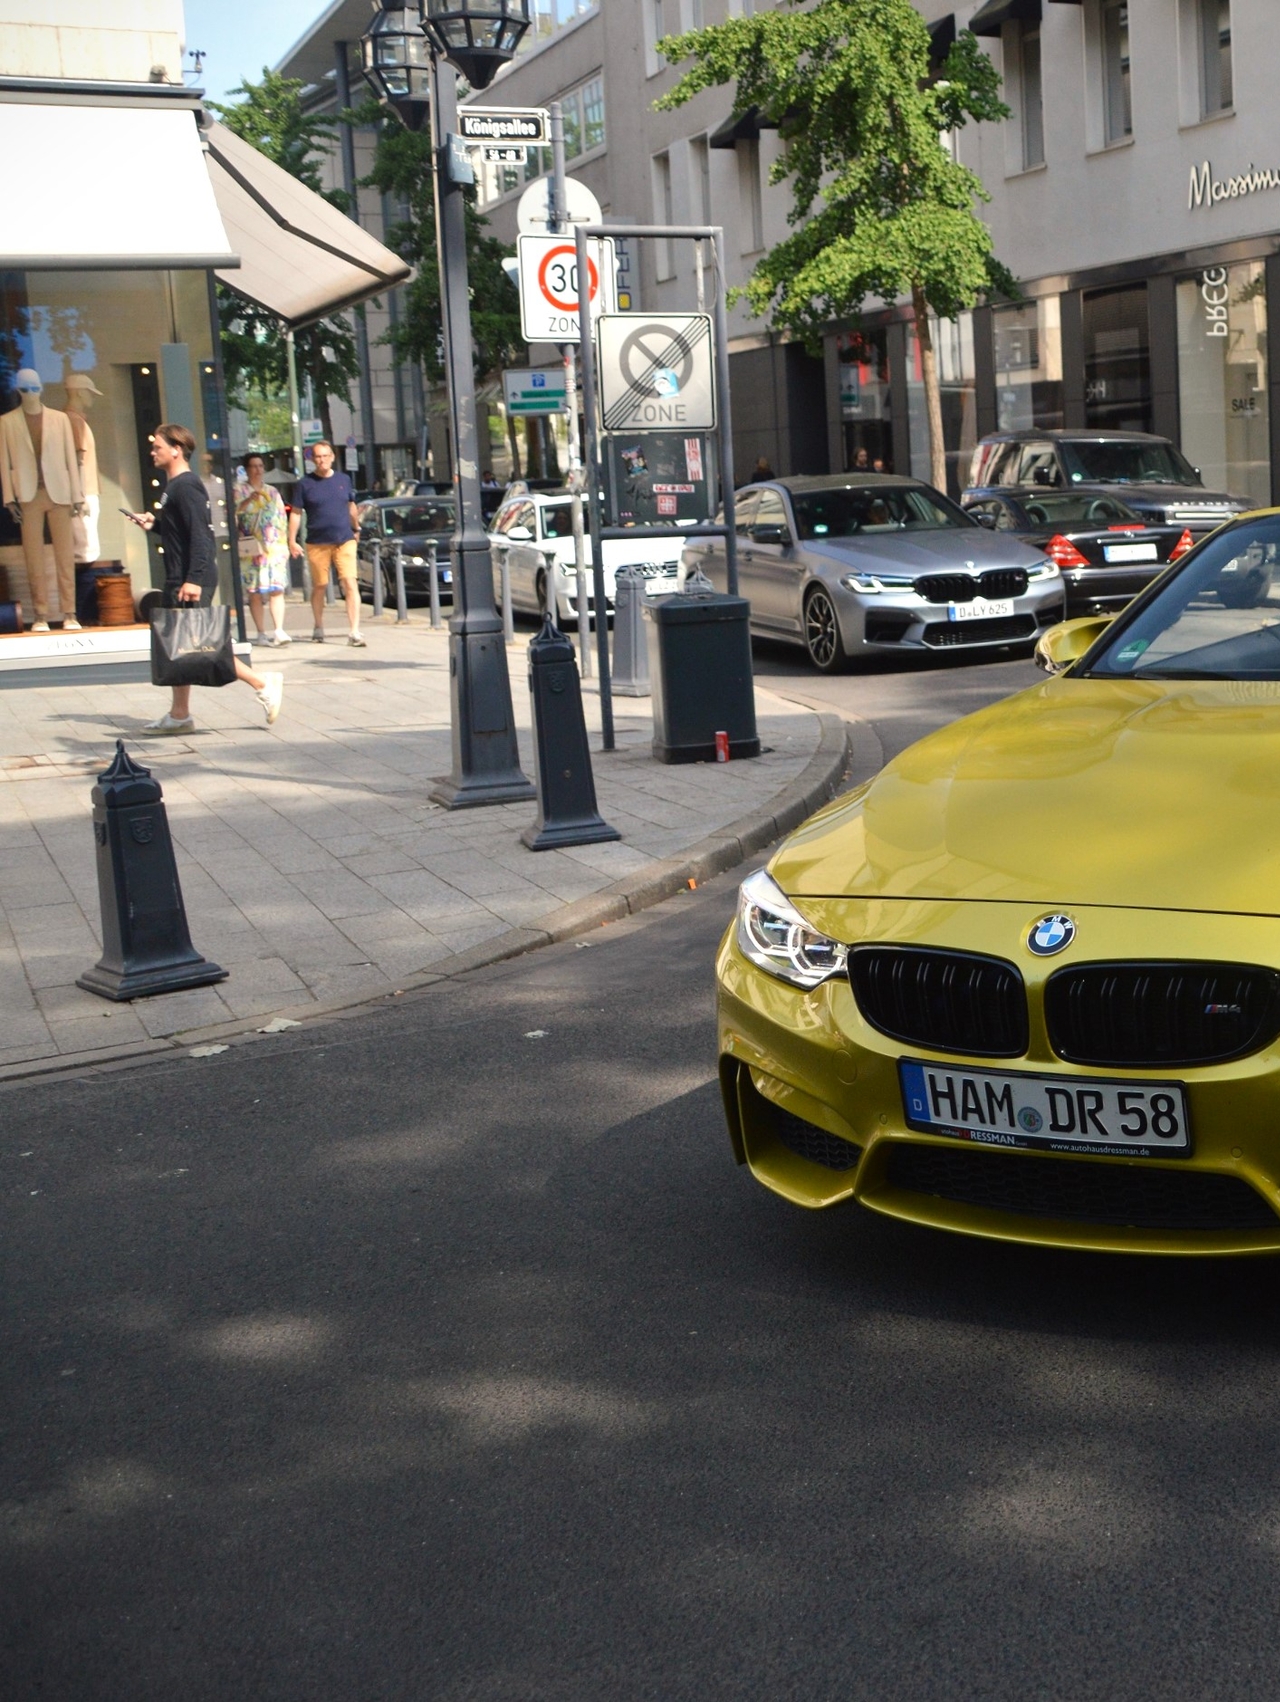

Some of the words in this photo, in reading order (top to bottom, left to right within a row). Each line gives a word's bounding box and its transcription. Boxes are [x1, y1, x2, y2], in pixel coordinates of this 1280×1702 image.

[465, 117, 536, 138] Königsallee
[1231, 397, 1256, 412] SALE
[631, 404, 686, 422] ZONE
[1036, 915, 1073, 930] BMW
[912, 1098, 923, 1111] D
[928, 1072, 1016, 1128] HAM
[1044, 1086, 1109, 1136] DR
[1116, 1090, 1180, 1139] 58
[1050, 1143, 1150, 1156] www.autohausdressman.de
